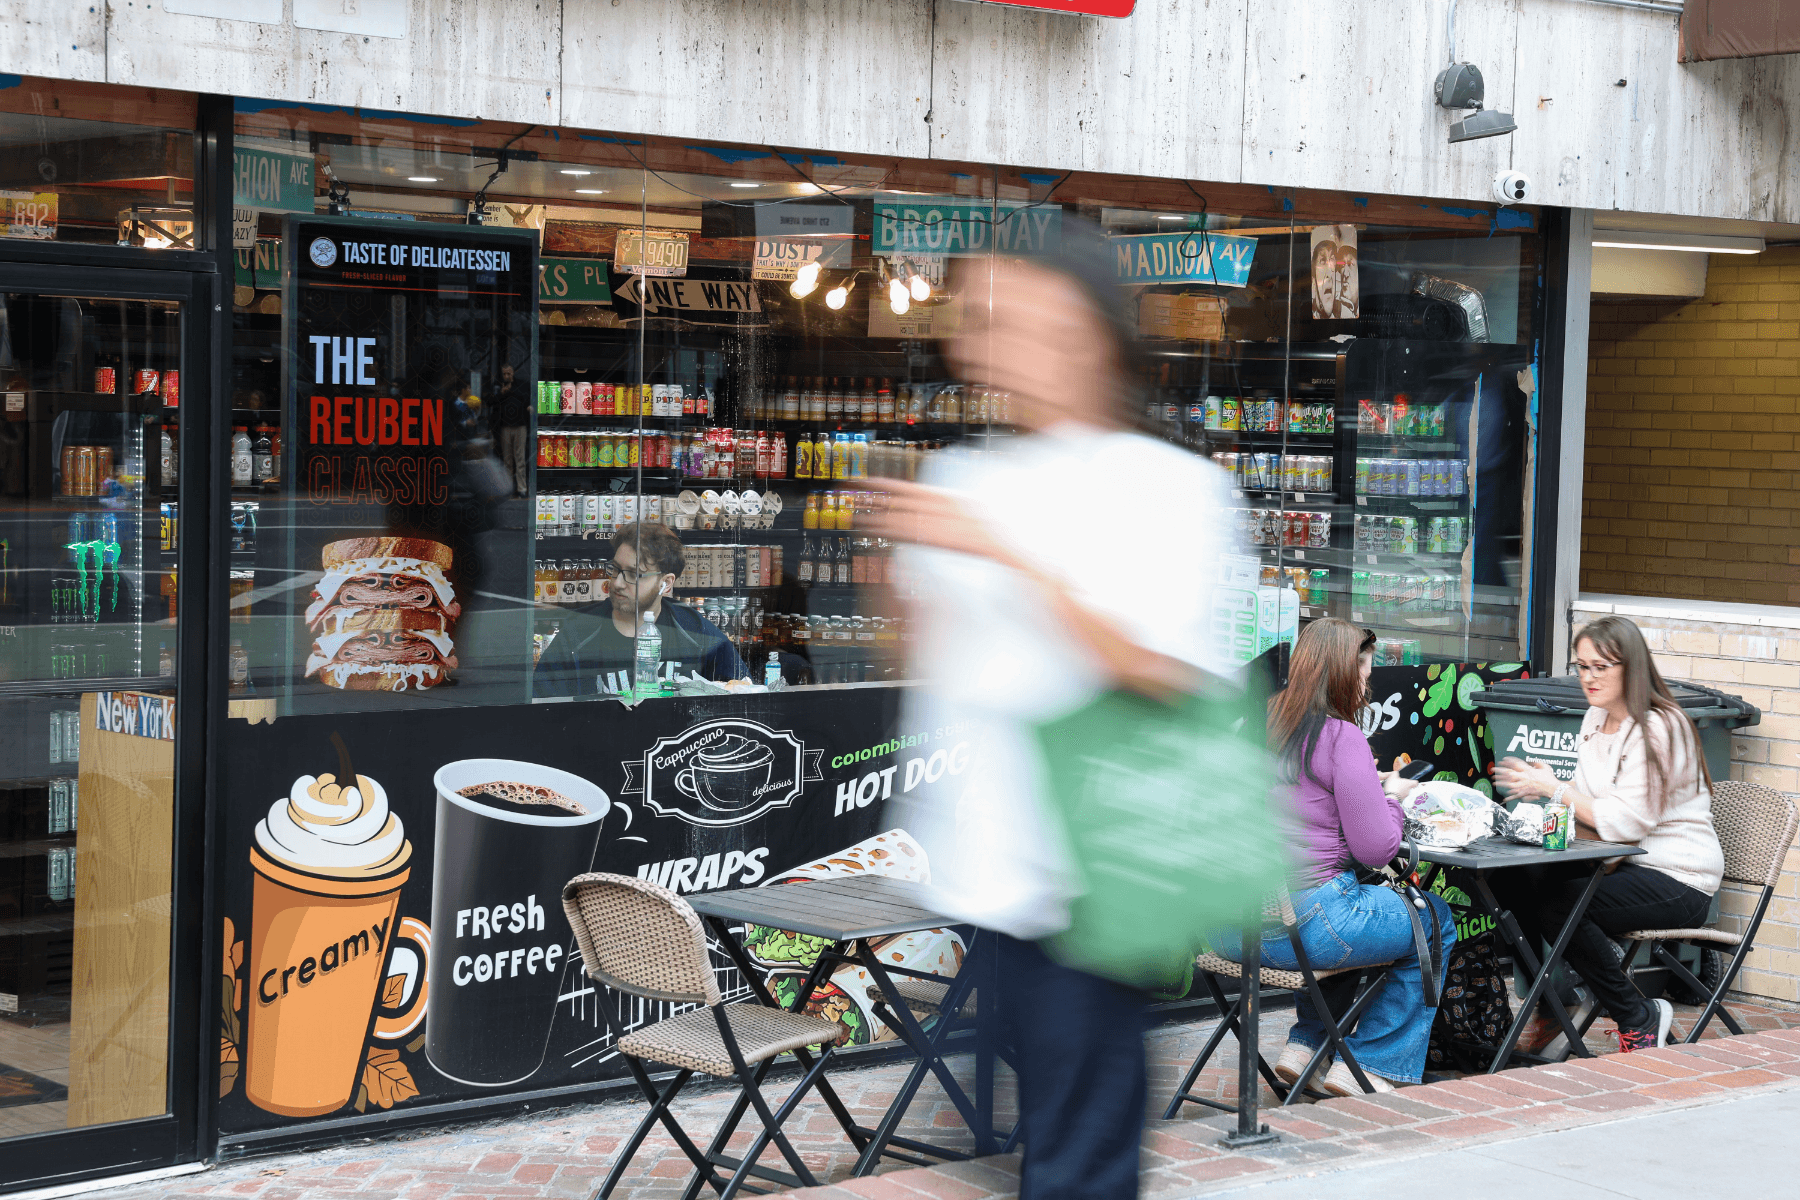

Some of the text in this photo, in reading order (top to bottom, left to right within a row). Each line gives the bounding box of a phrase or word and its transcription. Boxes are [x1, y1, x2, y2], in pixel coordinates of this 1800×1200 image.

[289, 161, 309, 186] AVE
[14, 201, 48, 229] 892
[881, 208, 1052, 250] BROADWAY
[233, 226, 252, 240] AZY
[238, 243, 280, 271] UNI
[342, 242, 387, 265] TASTE
[390, 244, 409, 266] OF
[412, 246, 511, 272] DELICATESSEN
[757, 241, 812, 261] DUST
[1117, 240, 1250, 277] MADISON AV
[342, 271, 407, 282] FRESH-SLICED FLAVOR
[584, 266, 606, 285] PL
[631, 265, 668, 274] Vemont
[633, 279, 753, 310] ONE WAY
[309, 335, 376, 386] THE
[310, 396, 444, 446] REUBEN
[308, 455, 449, 506] CLASSIC
[96, 692, 175, 740] New York
[654, 727, 725, 770] Cappuccino
[831, 730, 929, 769] colombian
[1564, 758, 1578, 767] Serv
[752, 777, 794, 797] delicious
[833, 741, 971, 818] HOT DOG
[1553, 768, 1576, 780] -9900
[637, 847, 770, 895] WRAPS
[257, 915, 390, 1005] Creamy
